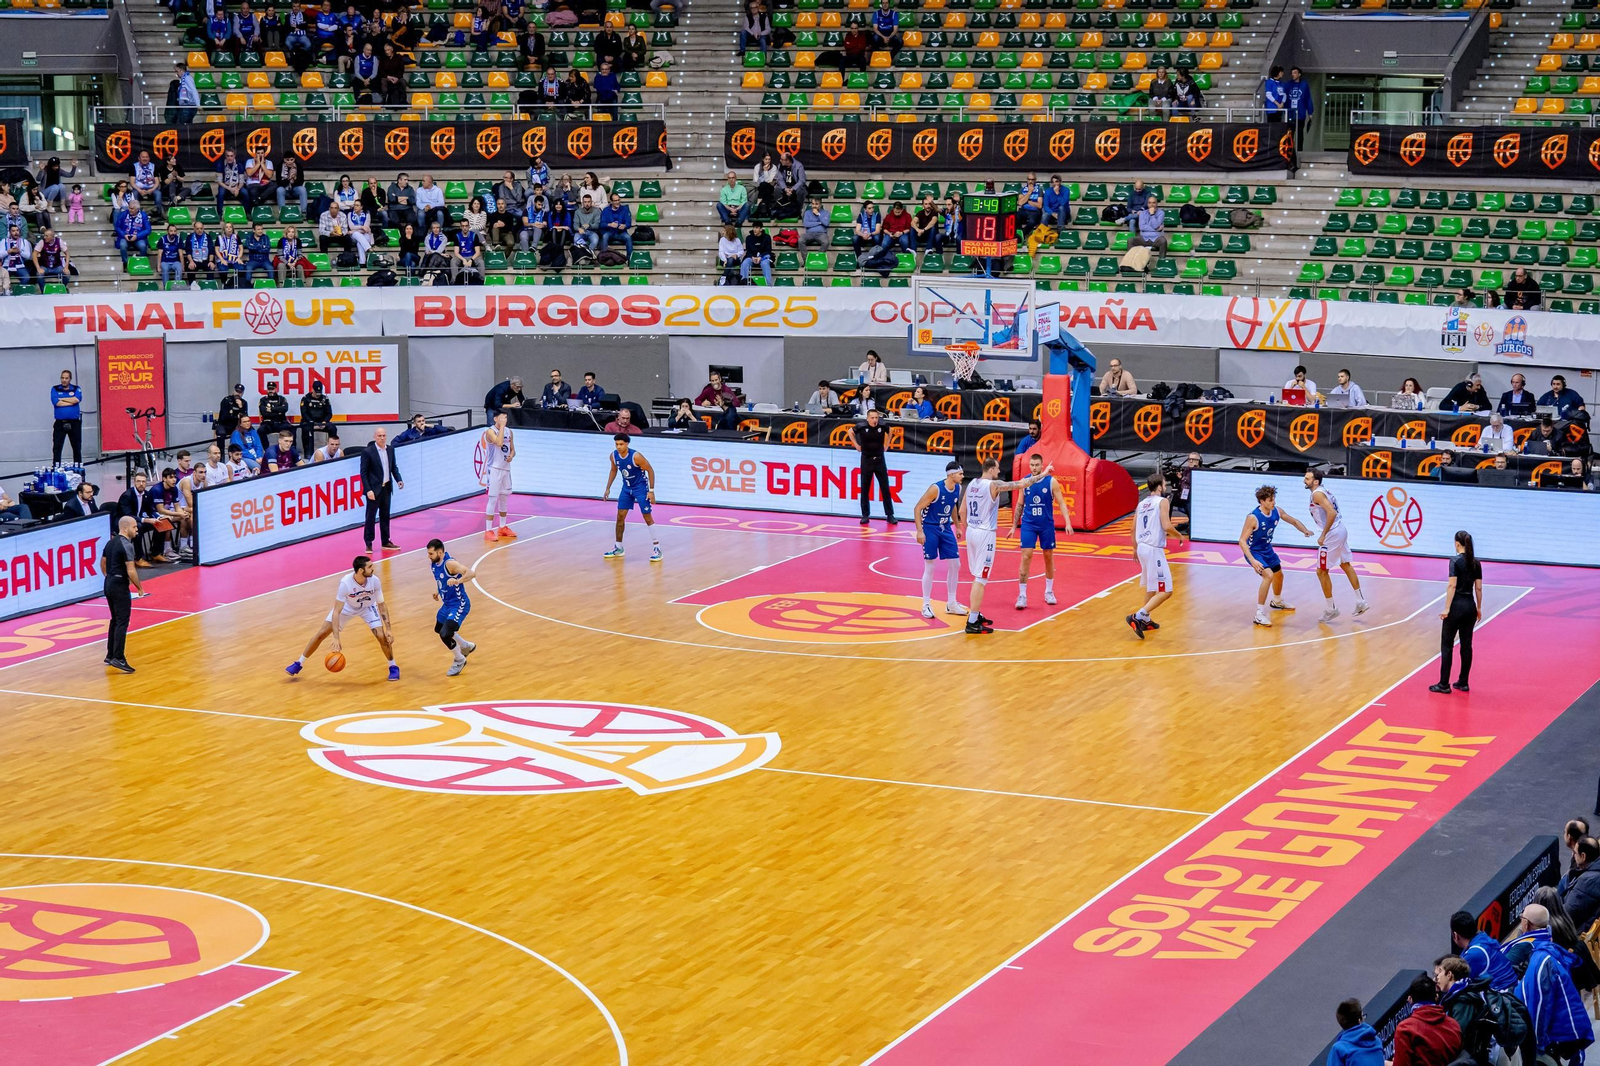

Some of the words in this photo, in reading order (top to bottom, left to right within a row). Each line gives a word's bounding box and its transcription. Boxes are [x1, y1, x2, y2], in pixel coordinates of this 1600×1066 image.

[972, 198, 999, 212] 3:49
[976, 216, 996, 241] 18
[1005, 214, 1015, 239] 18
[964, 246, 998, 256] GANAR
[54, 302, 205, 334] FINAL
[413, 294, 819, 328] BURGOS2025
[870, 300, 983, 324] COPA
[991, 298, 1158, 331] EAÑA
[257, 351, 318, 365] SOLO
[326, 350, 382, 364] VALE
[1497, 344, 1533, 356] BURGOS
[108, 361, 154, 372] FINAL
[252, 366, 388, 395] GANAR
[690, 456, 757, 476] SOLO
[692, 474, 757, 493] VALE
[760, 461, 911, 503] GANAR
[230, 494, 275, 520] SOLO
[276, 474, 365, 527] GANAR
[969, 501, 979, 517] 12
[1032, 507, 1043, 516] 88
[232, 513, 275, 539] VALE
[669, 515, 918, 540] COPA
[987, 543, 993, 551] 12
[1184, 718, 1497, 868] GANAR
[1072, 863, 1242, 958] SOLO
[1152, 874, 1324, 960] VALE
